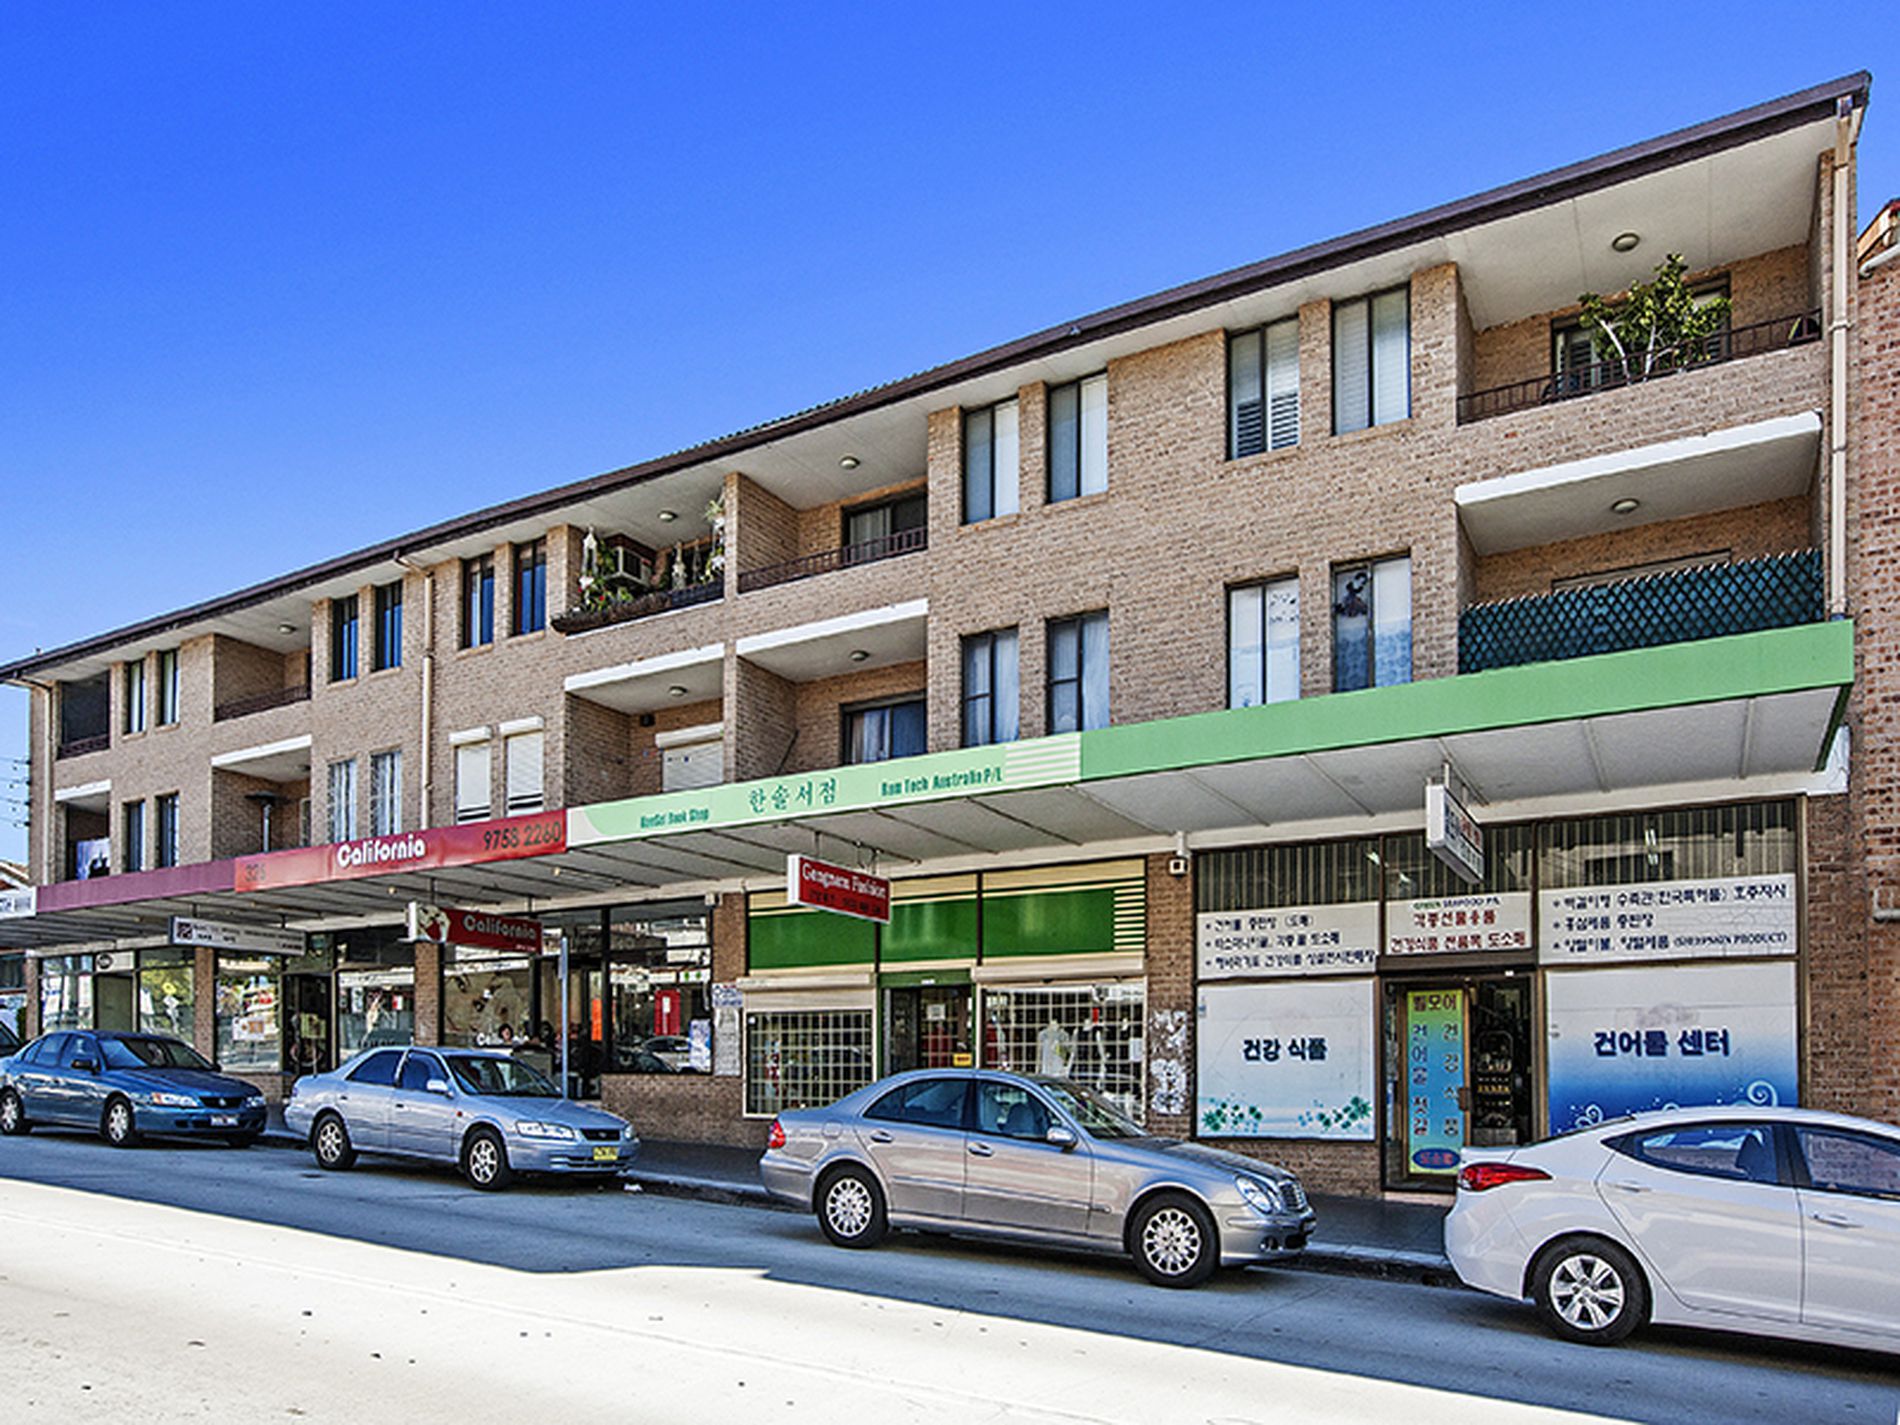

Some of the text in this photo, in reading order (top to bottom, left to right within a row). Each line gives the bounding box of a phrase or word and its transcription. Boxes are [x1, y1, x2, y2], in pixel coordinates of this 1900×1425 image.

[904, 776, 929, 792] Tech
[932, 770, 982, 790] Australia
[983, 766, 1002, 783] P/L
[749, 777, 837, 814] 한솔서점
[668, 810, 687, 825] Book
[689, 808, 709, 823] Shop
[523, 821, 563, 848] 2260
[336, 833, 425, 868] California
[1443, 897, 1484, 908] SEAFOOD
[1734, 883, 1787, 899] 호주지사
[463, 914, 537, 940] California
[1311, 931, 1341, 946] 도소매
[1390, 936, 1438, 953] 건강식품
[1488, 930, 1526, 948] 도소매
[1242, 1036, 1328, 1062] 건강 식품
[1593, 1027, 1731, 1058] 건어물 센터
